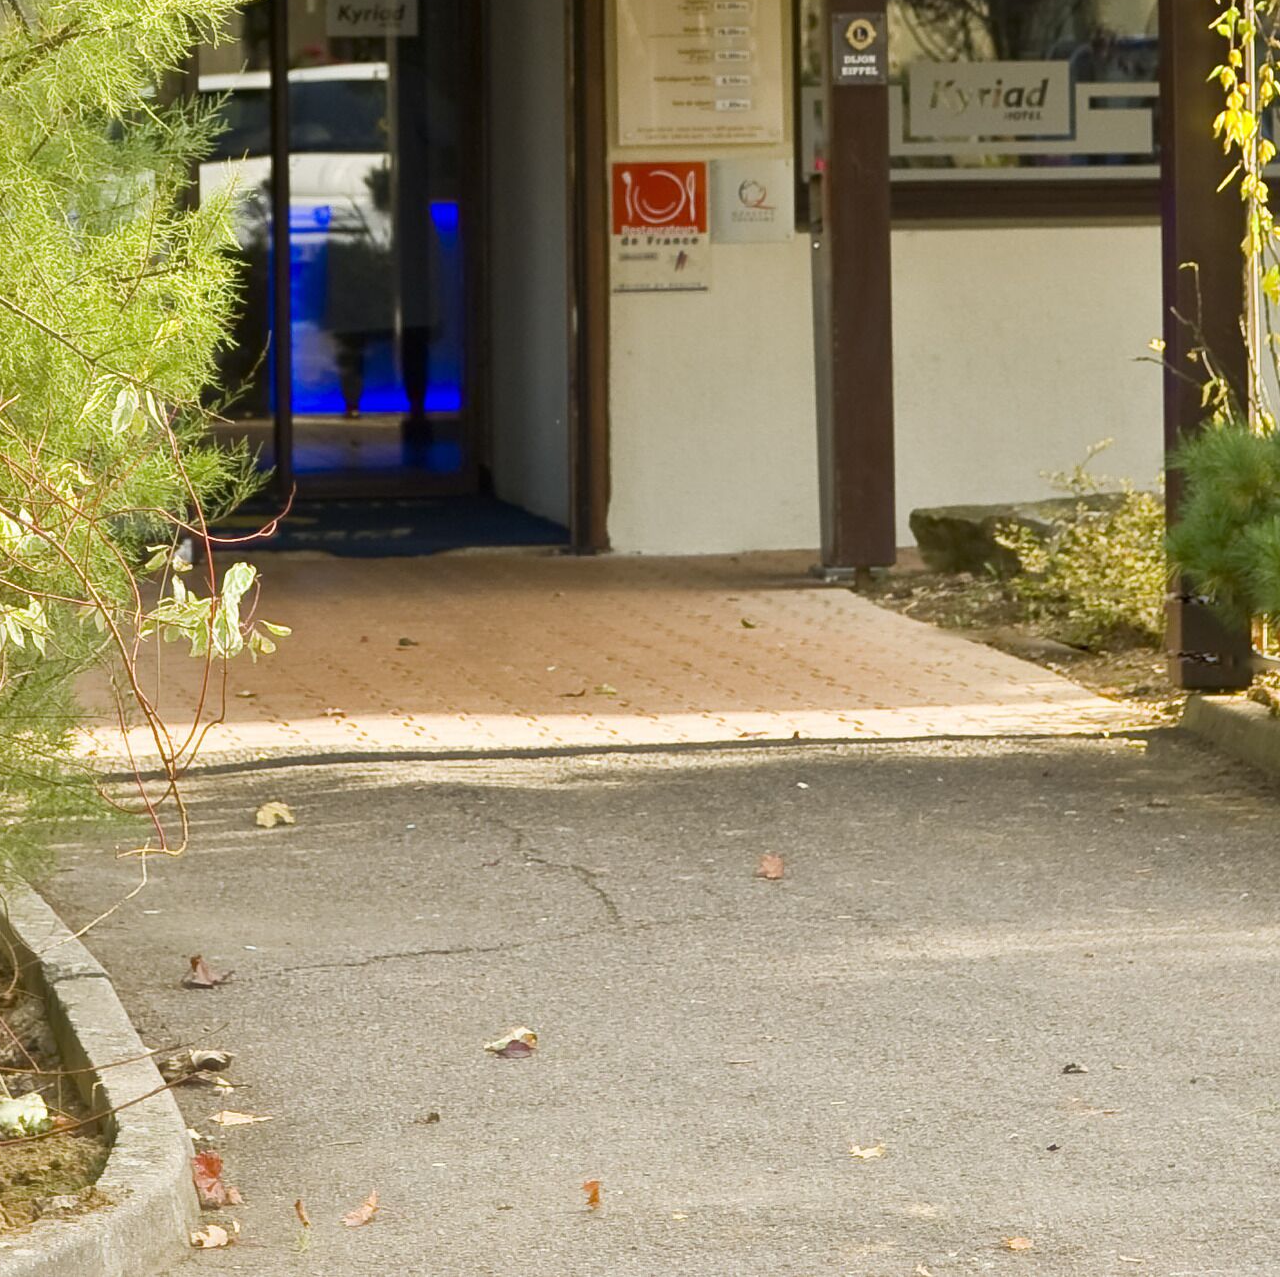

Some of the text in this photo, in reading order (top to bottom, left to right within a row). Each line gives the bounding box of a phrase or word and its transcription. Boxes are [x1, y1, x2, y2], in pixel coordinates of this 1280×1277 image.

[337, 3, 406, 25] Kyriad
[843, 54, 876, 64] DIJON
[841, 66, 879, 76] EIFFEL
[930, 78, 1049, 117] Kyriad
